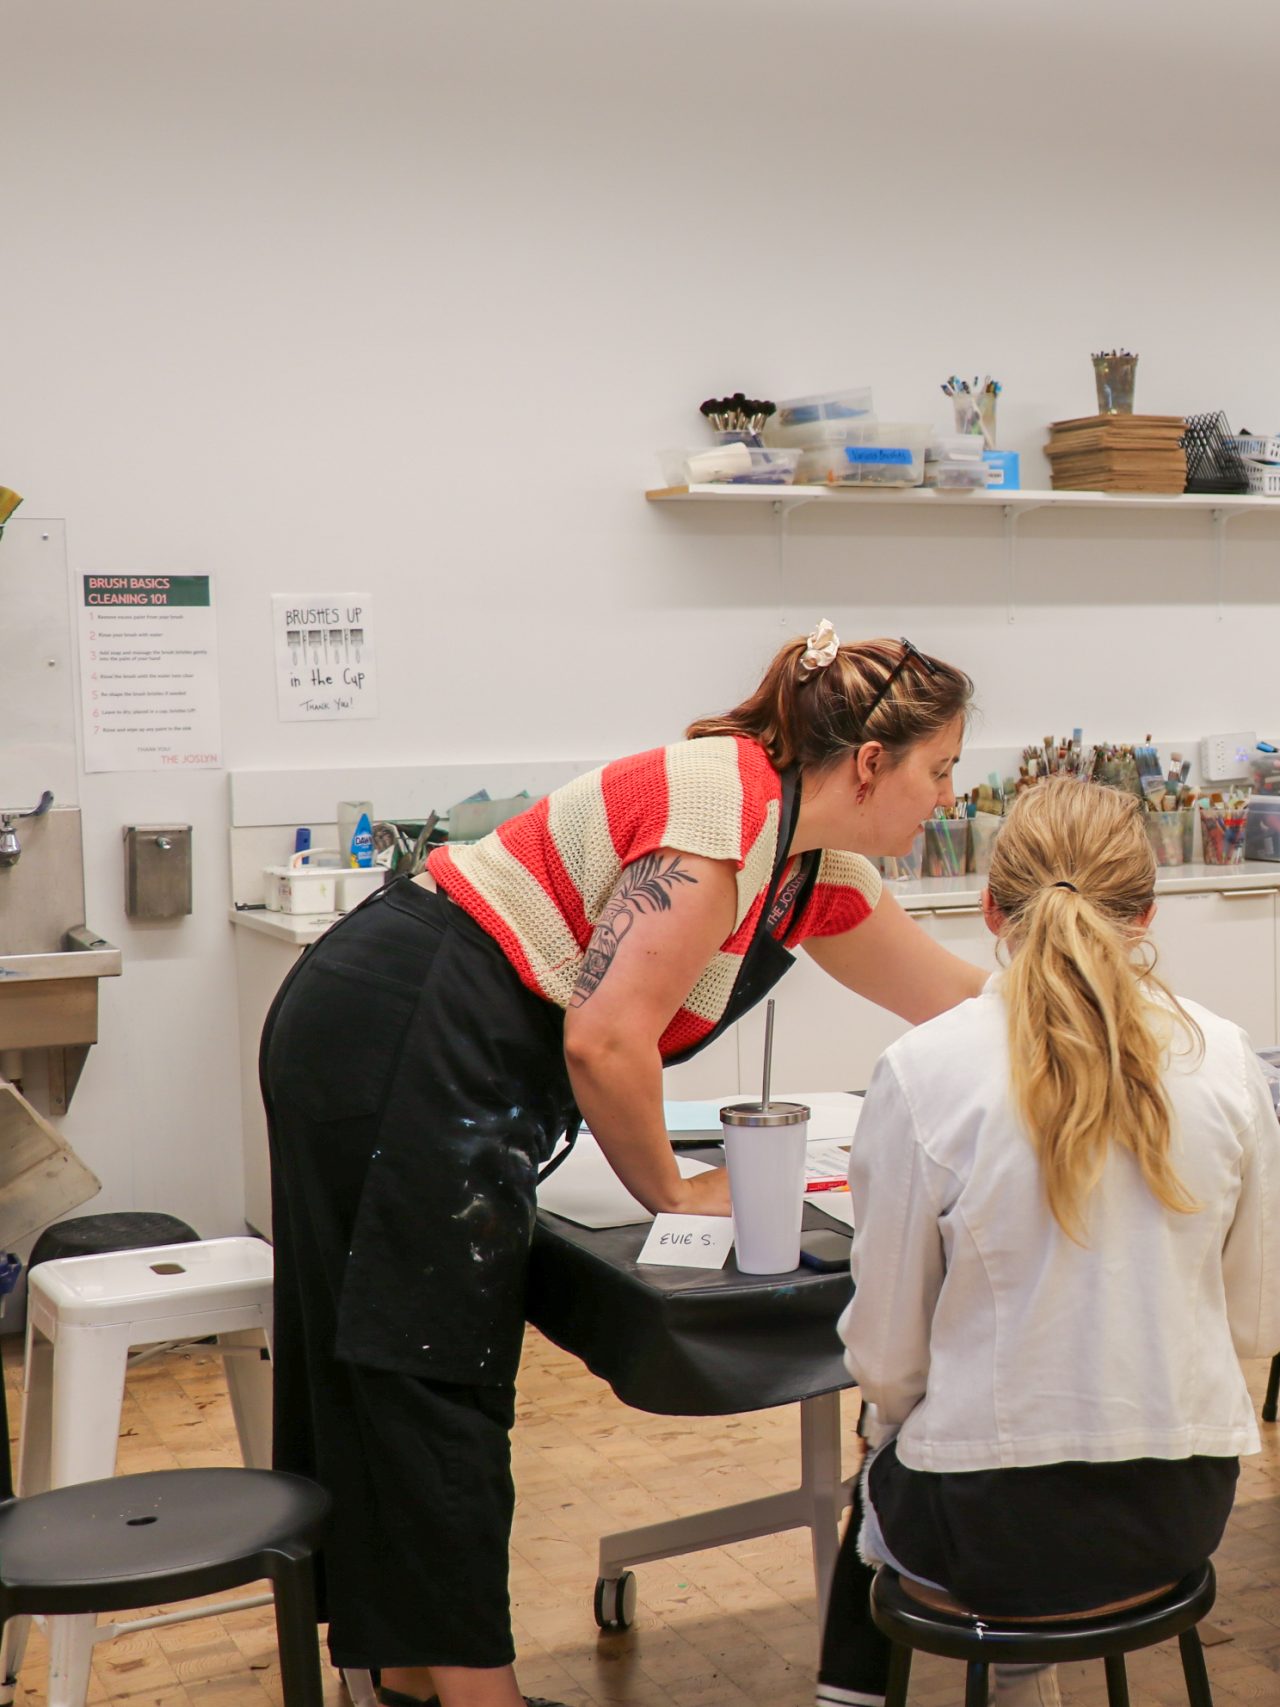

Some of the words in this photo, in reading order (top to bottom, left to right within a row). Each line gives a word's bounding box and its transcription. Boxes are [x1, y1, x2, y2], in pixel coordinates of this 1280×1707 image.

[88, 577, 128, 589] BRUSH
[130, 577, 171, 589] BASICS
[87, 593, 148, 604] CLEANING
[150, 593, 167, 604] 101
[286, 608, 340, 626] BRUSHES
[346, 607, 362, 624] UP
[290, 671, 301, 688] in
[311, 668, 333, 686] the
[343, 667, 366, 690] Cup
[161, 755, 178, 764] THE
[182, 754, 218, 764] JOSLYN
[660, 1233, 693, 1245] EVIE
